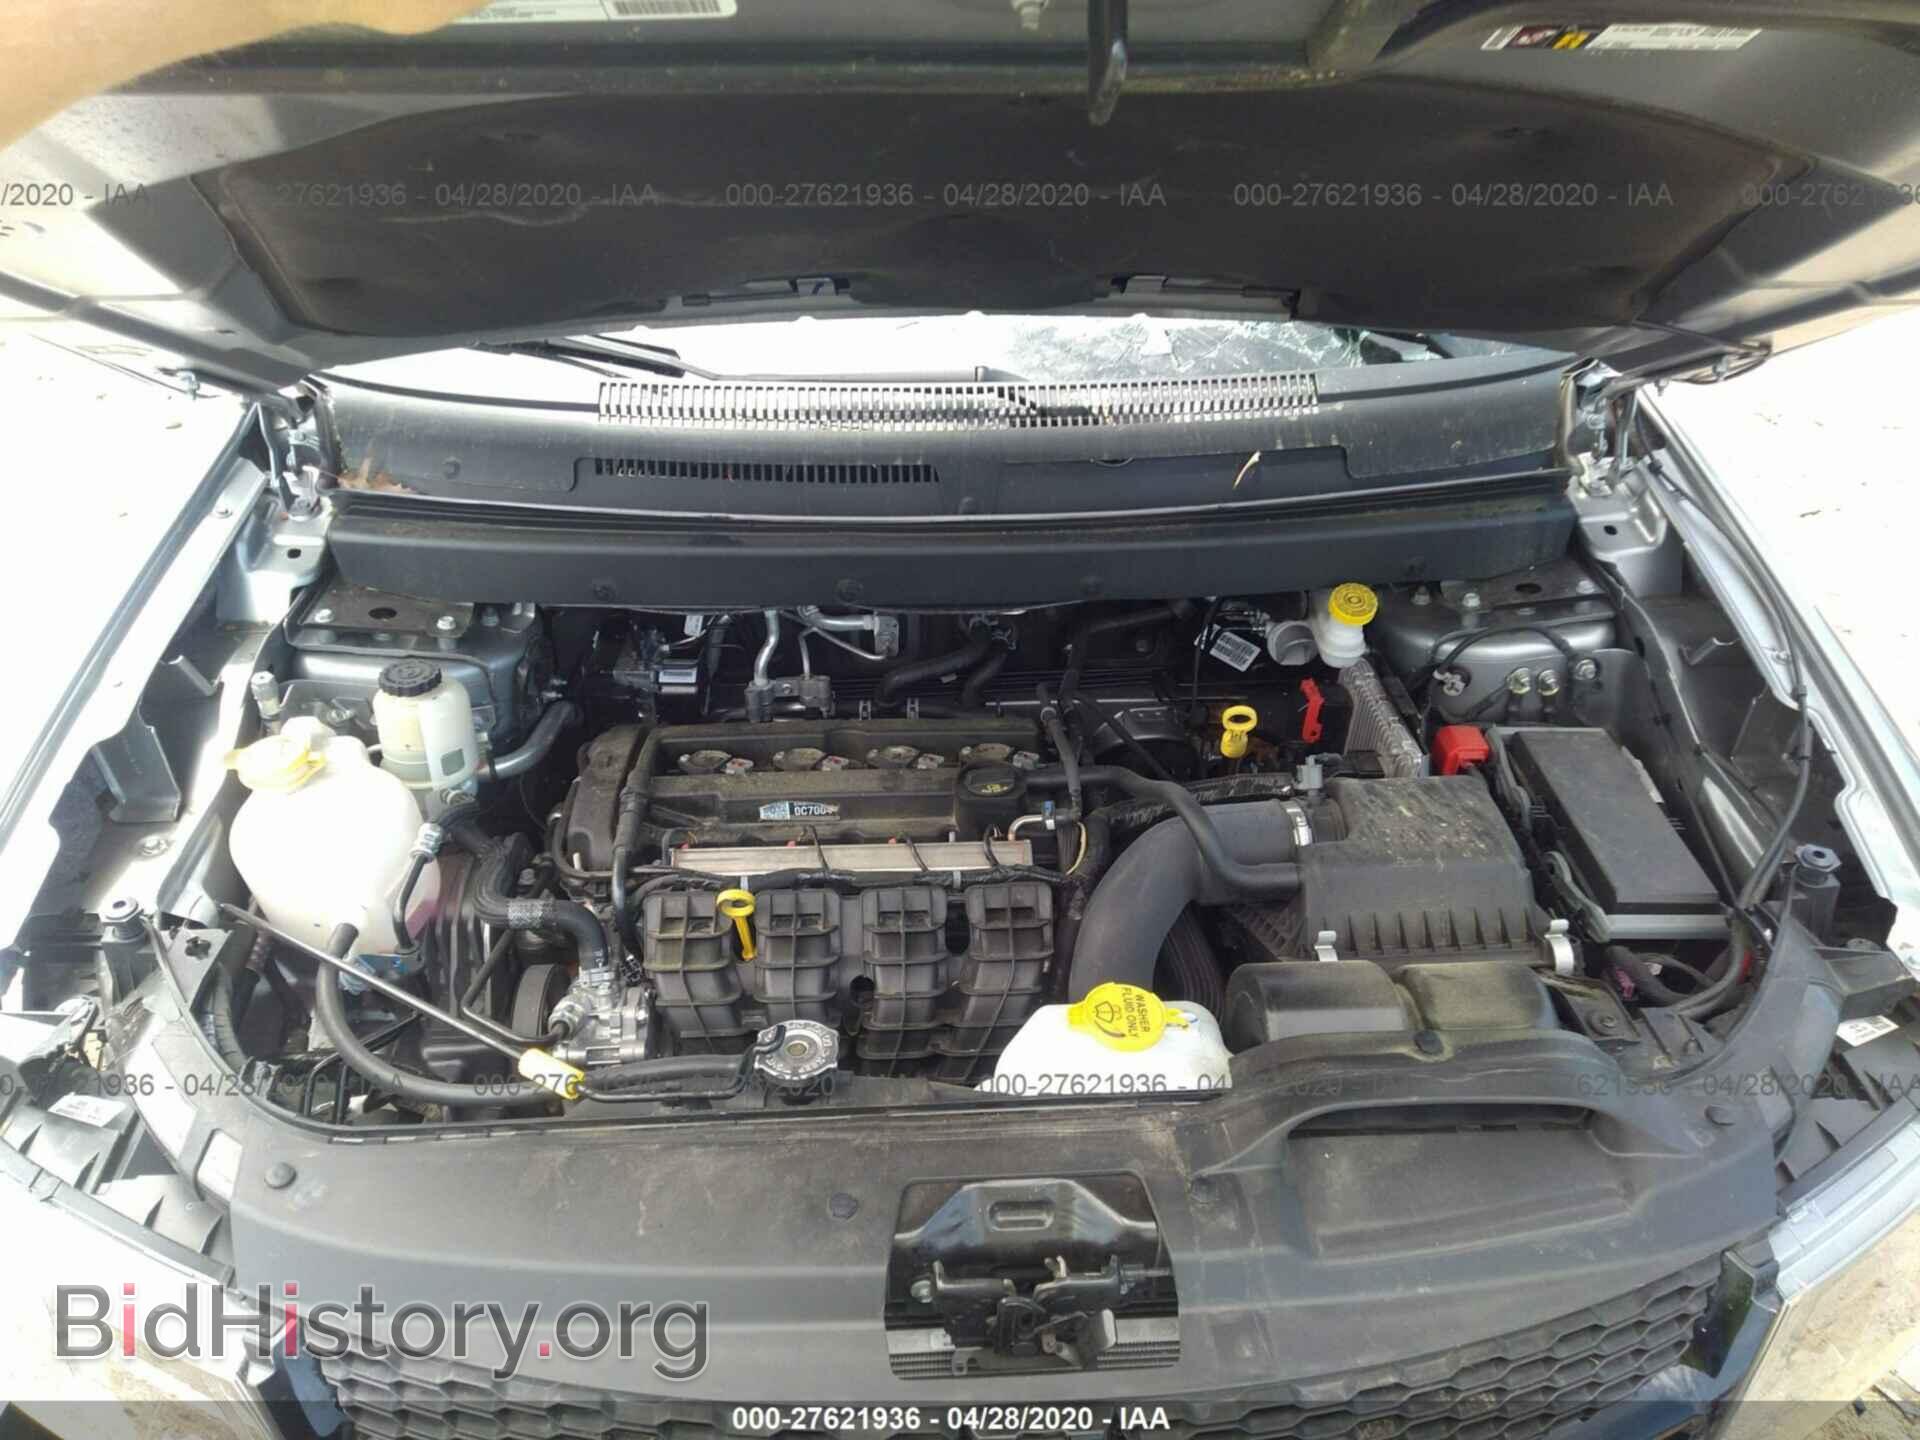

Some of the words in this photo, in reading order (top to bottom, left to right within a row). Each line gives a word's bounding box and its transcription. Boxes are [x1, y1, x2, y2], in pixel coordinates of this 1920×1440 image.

[1122, 987, 1135, 1013] FLUID
[1136, 994, 1151, 1032] WASHER
[1126, 1014, 1139, 1038] ONLY
